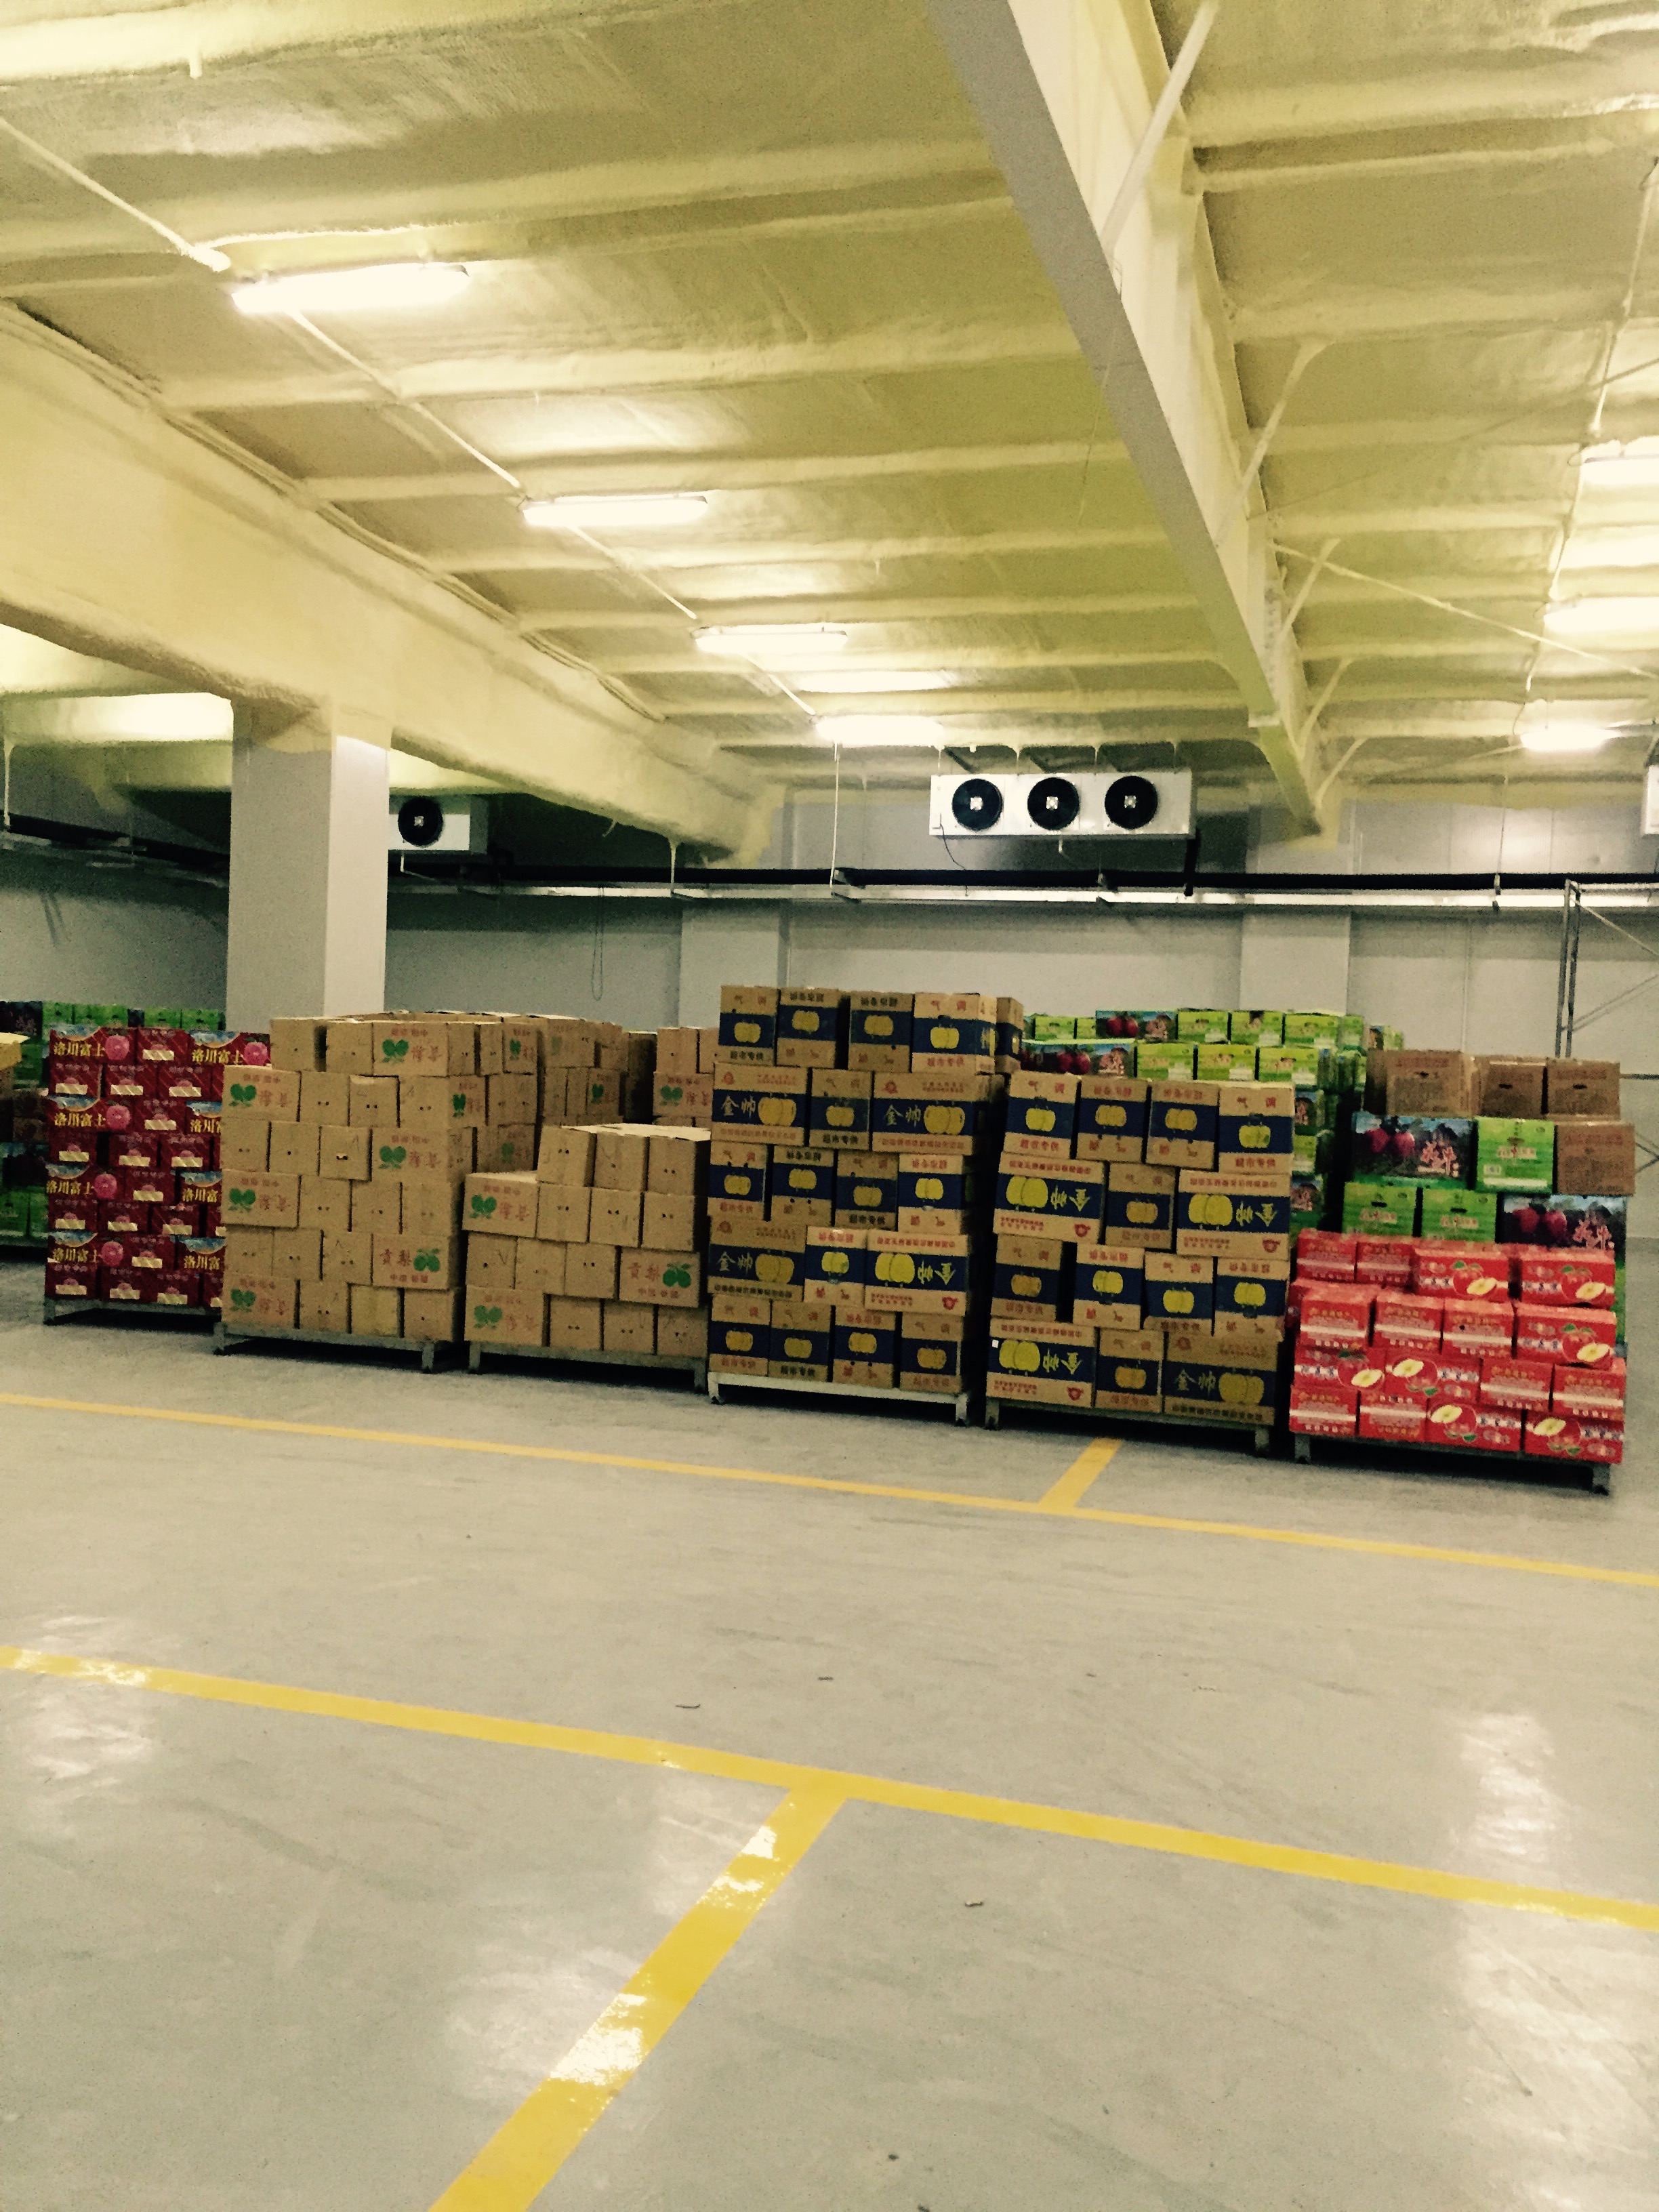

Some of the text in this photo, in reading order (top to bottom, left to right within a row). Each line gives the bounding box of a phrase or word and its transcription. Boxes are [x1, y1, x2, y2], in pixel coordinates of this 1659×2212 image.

[54, 1040, 106, 1057] 洛川富士
[192, 1048, 243, 1065] 洛川富士
[720, 1095, 756, 1120] 金帅
[884, 1105, 922, 1126] 金帅
[54, 1111, 106, 1128] 洛川富士
[1235, 1158, 1275, 1168] 超市专供
[47, 1180, 94, 1195] 洛川富士
[1050, 1185, 1090, 1211] 金帅
[1236, 1202, 1277, 1227] 金帅
[53, 1248, 98, 1264] 洛川富士
[716, 1251, 754, 1271] 金帅
[917, 1261, 956, 1285] 金帅
[1043, 1349, 1082, 1374] 金帅
[1174, 1370, 1216, 1395] 金帅
